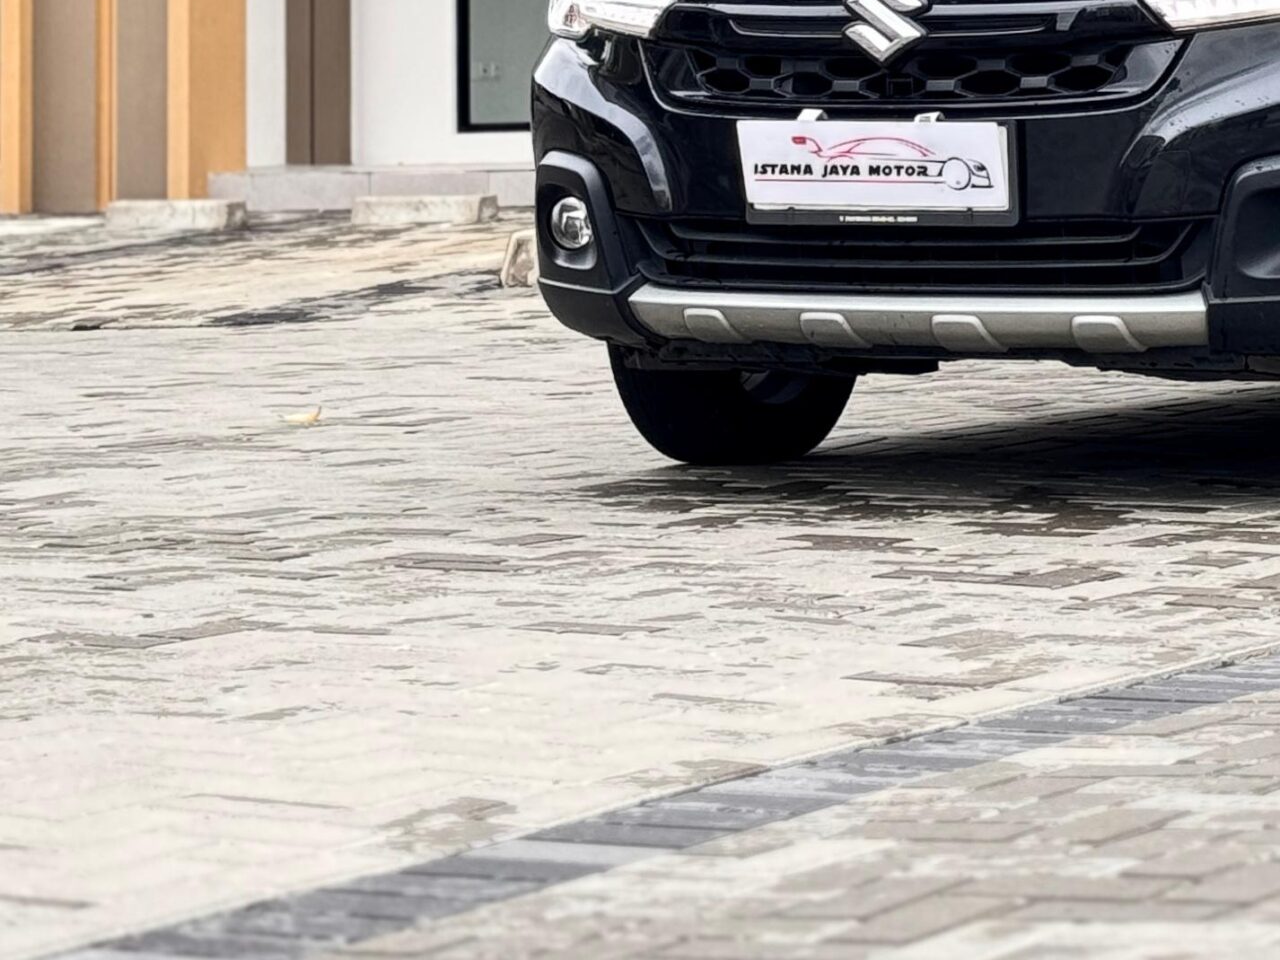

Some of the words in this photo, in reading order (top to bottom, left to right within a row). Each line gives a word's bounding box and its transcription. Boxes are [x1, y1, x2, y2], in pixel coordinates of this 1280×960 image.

[753, 163, 814, 176] ISTANA
[821, 164, 861, 178] JAYA
[867, 164, 929, 177] MOTOR
